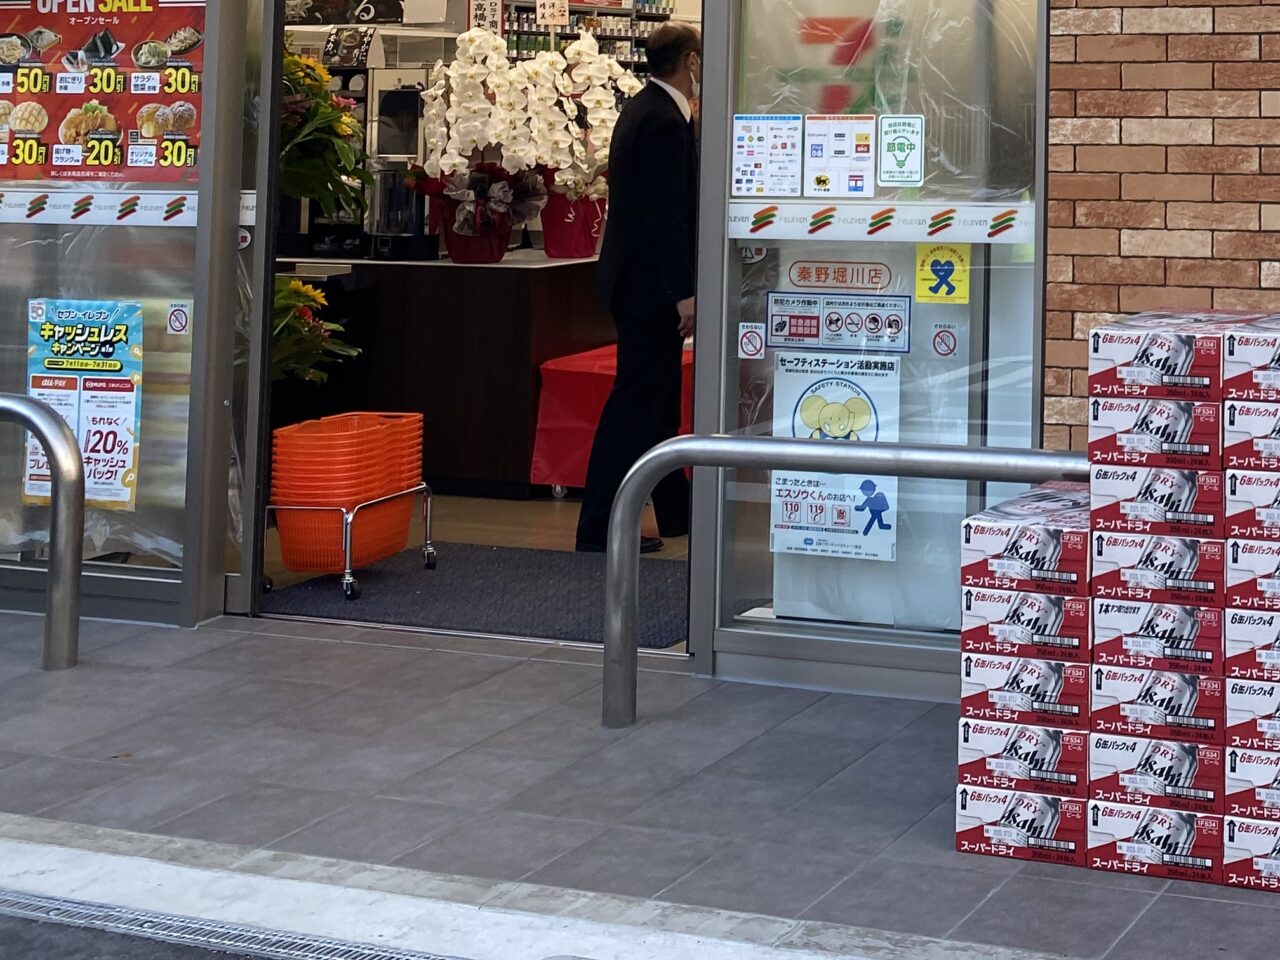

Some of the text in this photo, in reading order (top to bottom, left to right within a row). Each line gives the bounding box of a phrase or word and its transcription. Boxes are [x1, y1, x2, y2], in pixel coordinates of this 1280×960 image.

[69, 16, 120, 25] オープンセール
[886, 142, 916, 153] 節電中
[797, 266, 883, 285] 秦野堀川店
[773, 298, 818, 306] 防犯カメラ作動中
[40, 322, 128, 344] キャッシュレス
[51, 341, 99, 357] キャンペーン
[779, 356, 895, 372] セーフティステーション活動実施店
[810, 381, 862, 397] SAFETY STATION
[1093, 382, 1148, 396] スーパードライ
[91, 416, 121, 426] もれなく
[84, 456, 127, 469] キャッシュ
[784, 502, 799, 513] 110
[809, 504, 824, 514] 119
[965, 575, 1018, 589] スーパードライ
[1097, 585, 1152, 599] スーパードライ
[966, 707, 1019, 721] スーパードライ
[961, 841, 1014, 855] スーパードライ
[1093, 858, 1148, 872] スーパードライ
